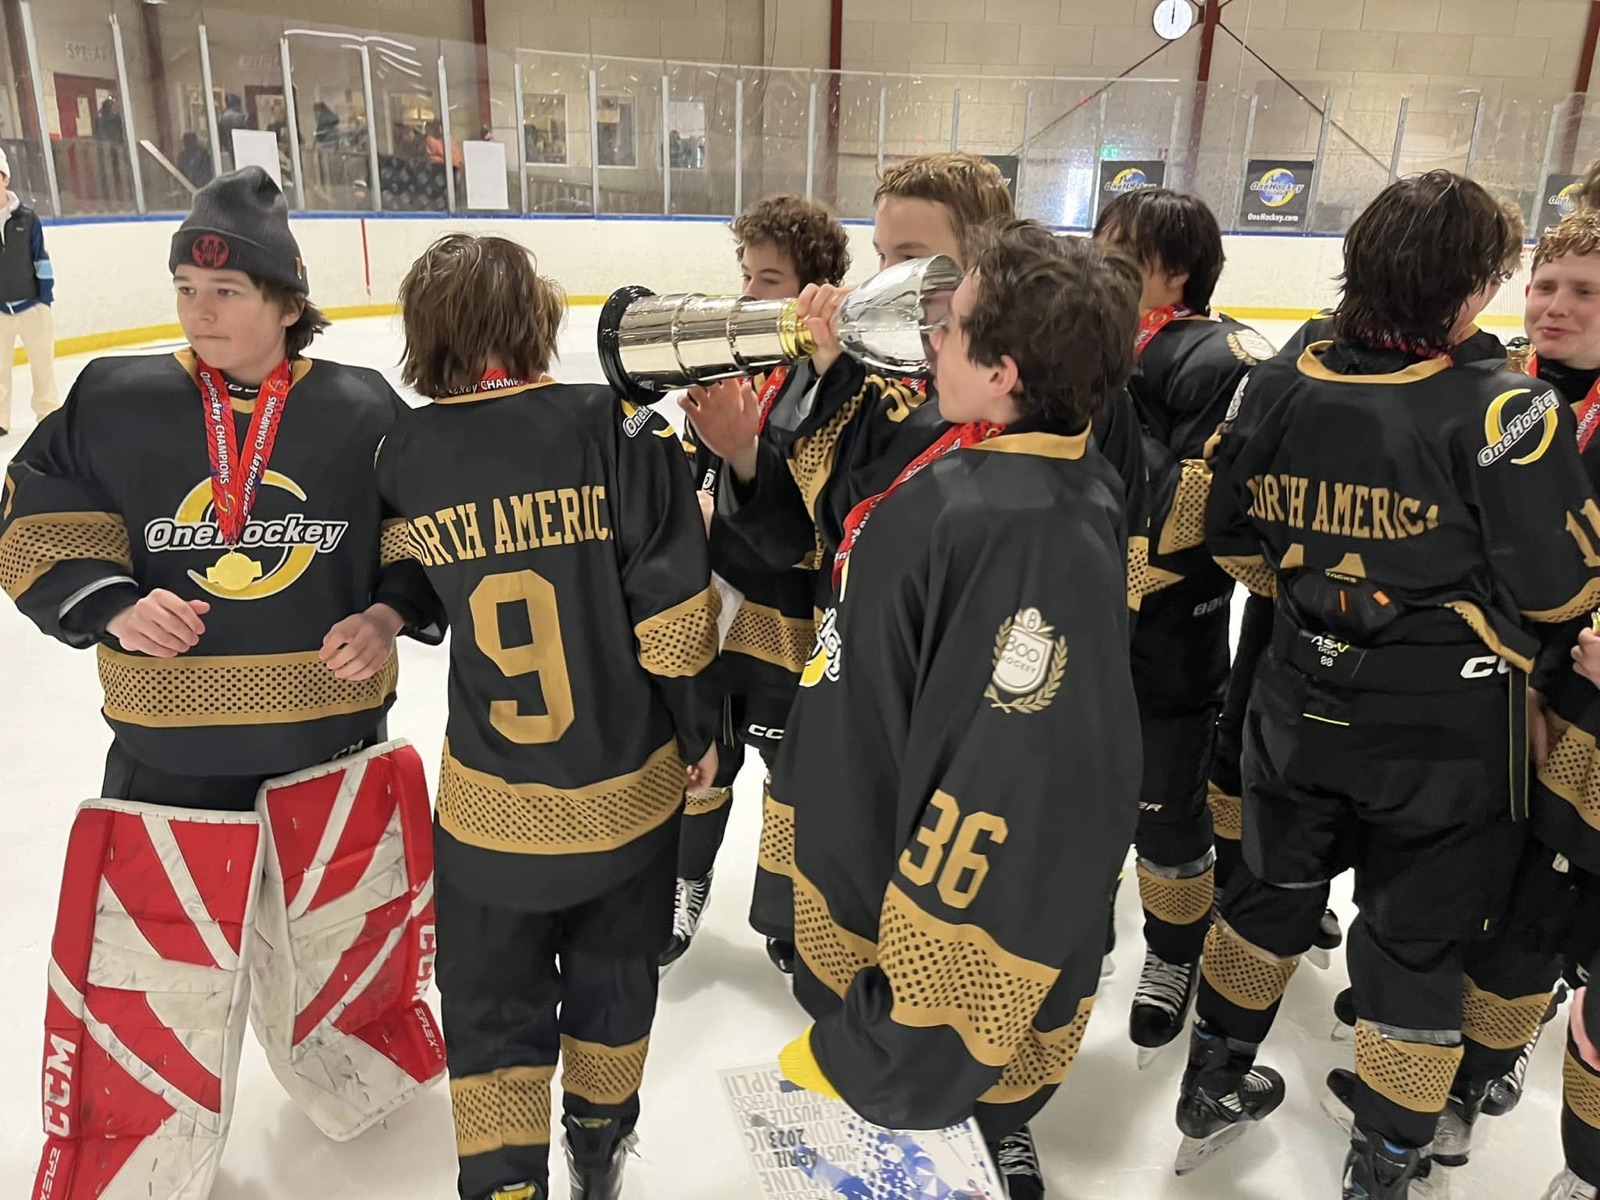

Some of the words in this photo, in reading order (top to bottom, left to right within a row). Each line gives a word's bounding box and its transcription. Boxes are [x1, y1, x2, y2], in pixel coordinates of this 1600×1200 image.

[1247, 212, 1299, 222] OneHockey.com
[215, 424, 230, 485] CHAMPIONS
[254, 395, 277, 450] CHAMPIONS
[1478, 389, 1560, 467] OneHockey
[493, 485, 613, 554] AMERIC
[468, 568, 575, 745] 9
[748, 723, 785, 740] CC
[898, 788, 1009, 909] 36
[410, 924, 437, 1002] CCM
[44, 1033, 77, 1138] CCM
[769, 1128, 806, 1149] 2023
[773, 1147, 818, 1170] APRIL
